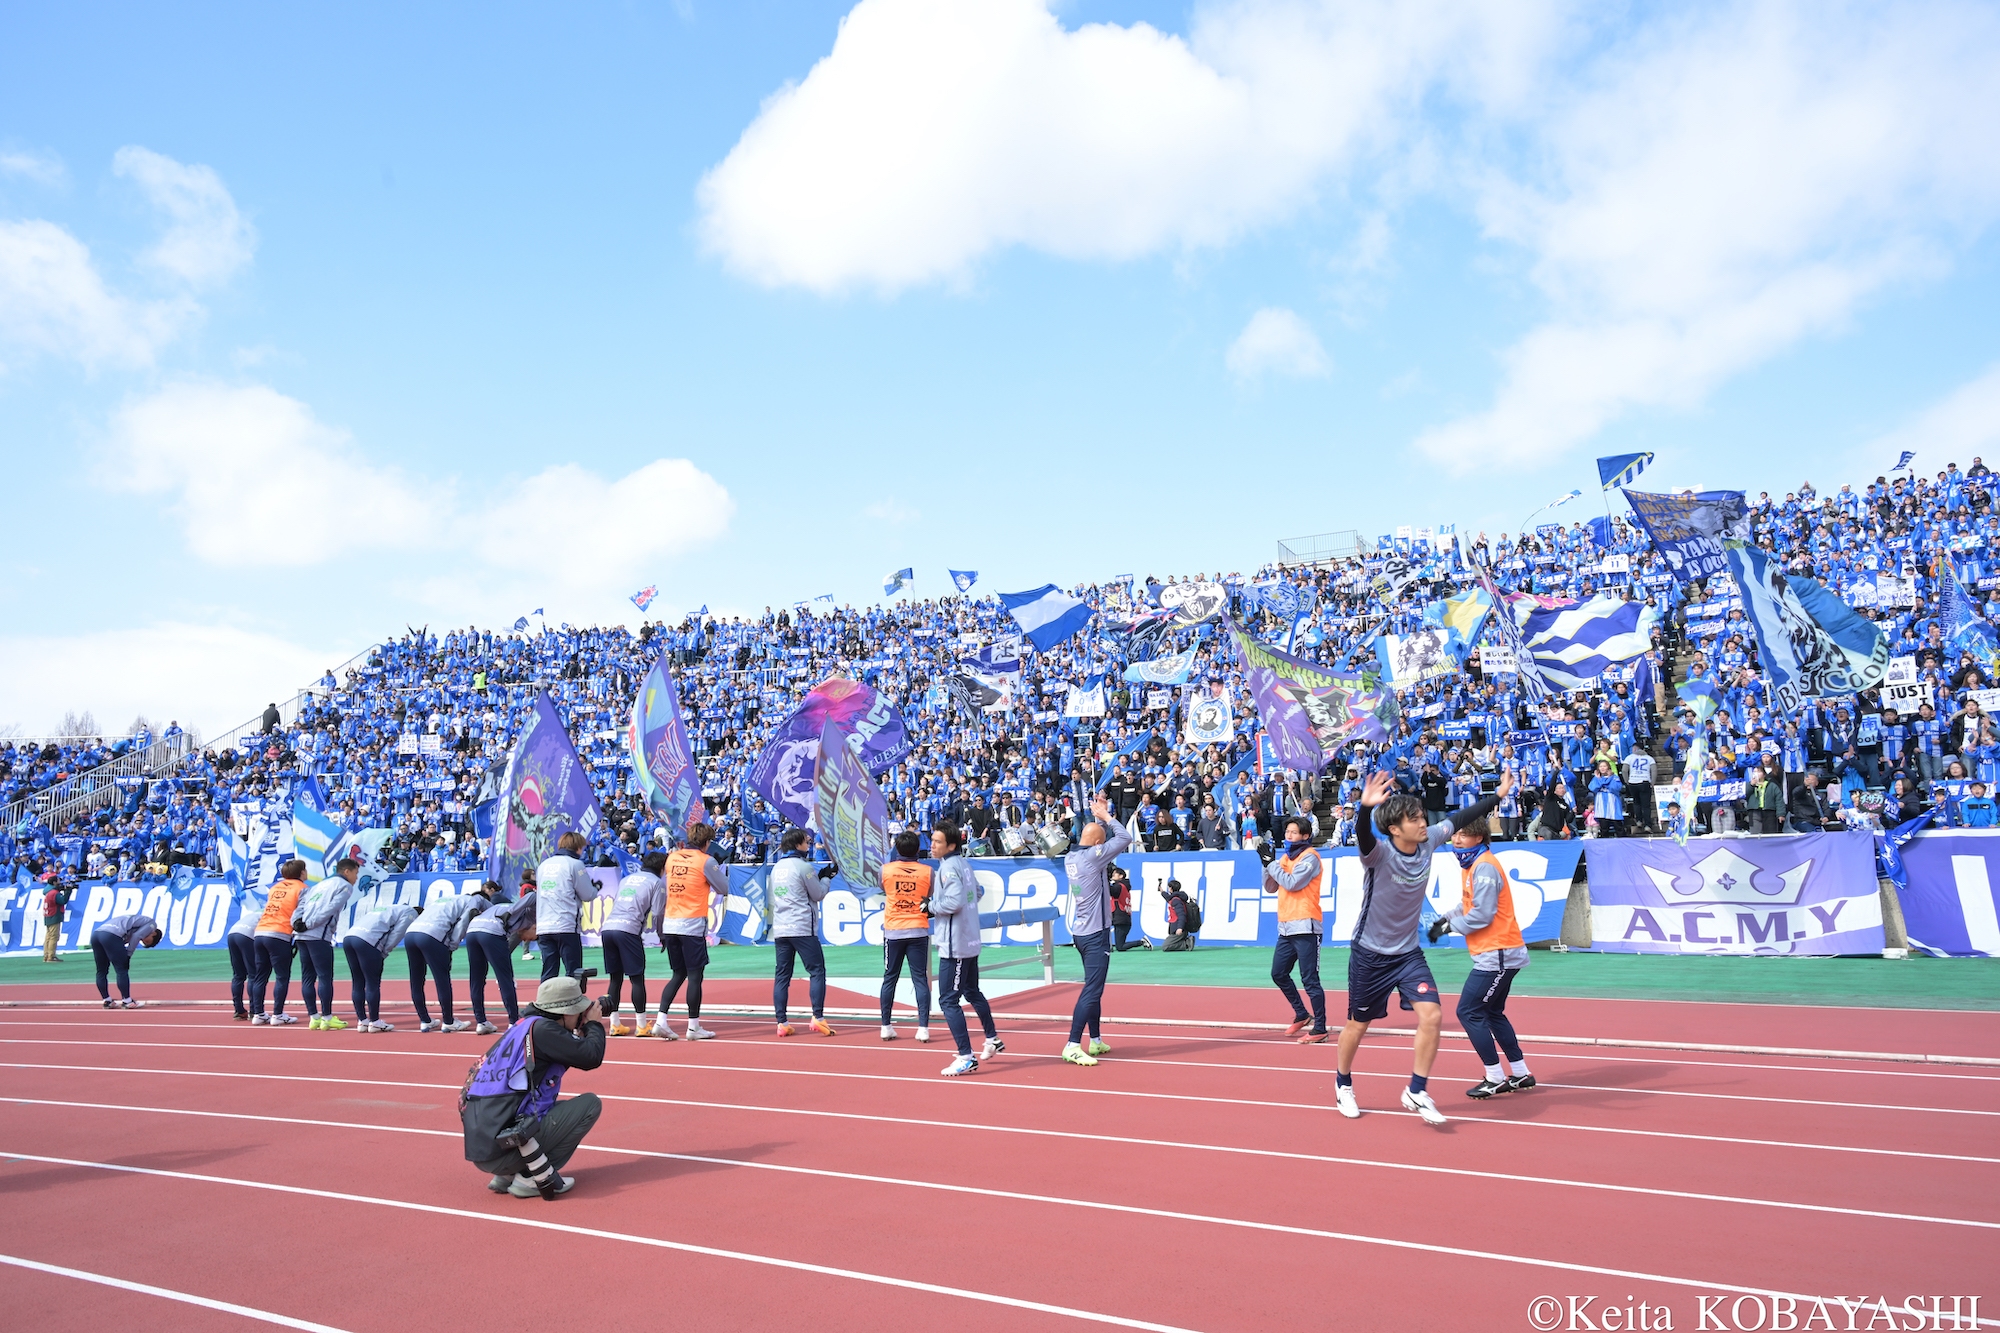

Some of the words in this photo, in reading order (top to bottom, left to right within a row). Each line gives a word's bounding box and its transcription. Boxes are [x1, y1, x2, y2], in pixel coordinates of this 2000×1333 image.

[1611, 560, 1619, 568] 11
[1684, 559, 1702, 578] IS
[1890, 683, 1927, 700] JUST
[1437, 723, 1445, 737] 4
[1860, 716, 1876, 731] 南
[1632, 758, 1648, 772] 42
[76, 883, 233, 947] PROUD
[1622, 900, 1849, 944] A.C.M.Y
